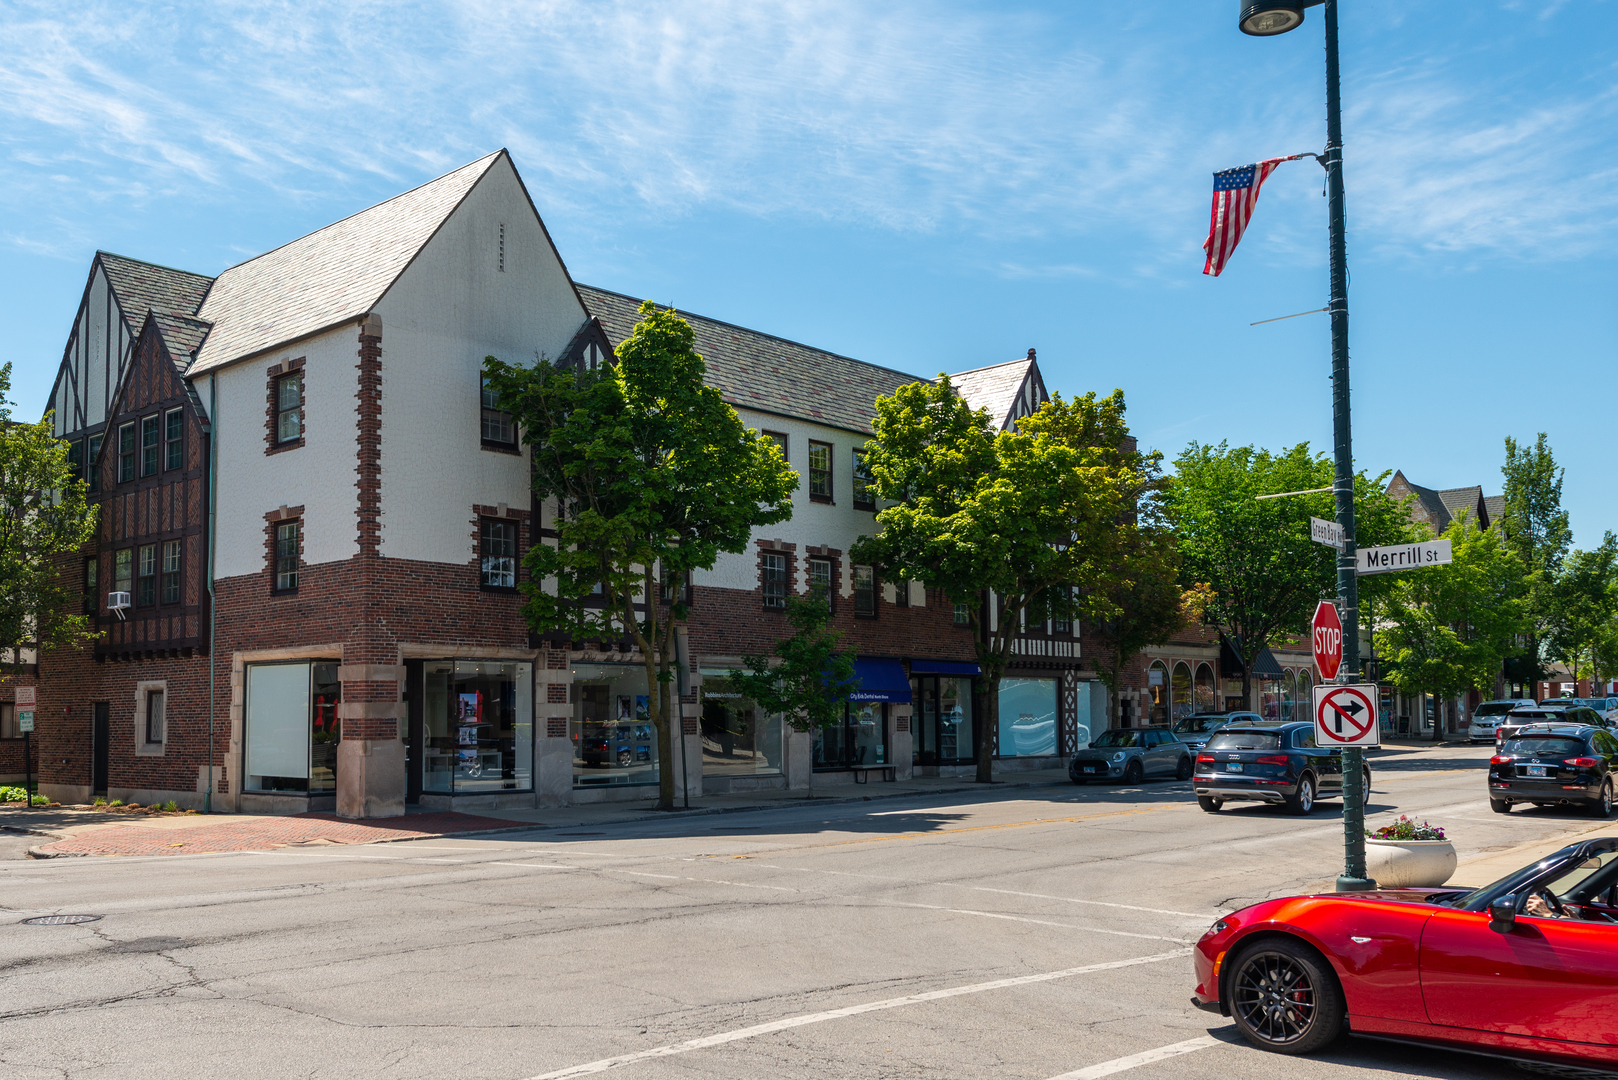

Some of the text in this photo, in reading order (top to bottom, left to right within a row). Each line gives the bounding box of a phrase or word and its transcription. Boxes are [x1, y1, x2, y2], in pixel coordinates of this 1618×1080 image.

[1313, 520, 1327, 539] Green
[1327, 523, 1337, 545] Bay
[1367, 546, 1438, 568] Merrill St
[1315, 626, 1340, 655] STOP
